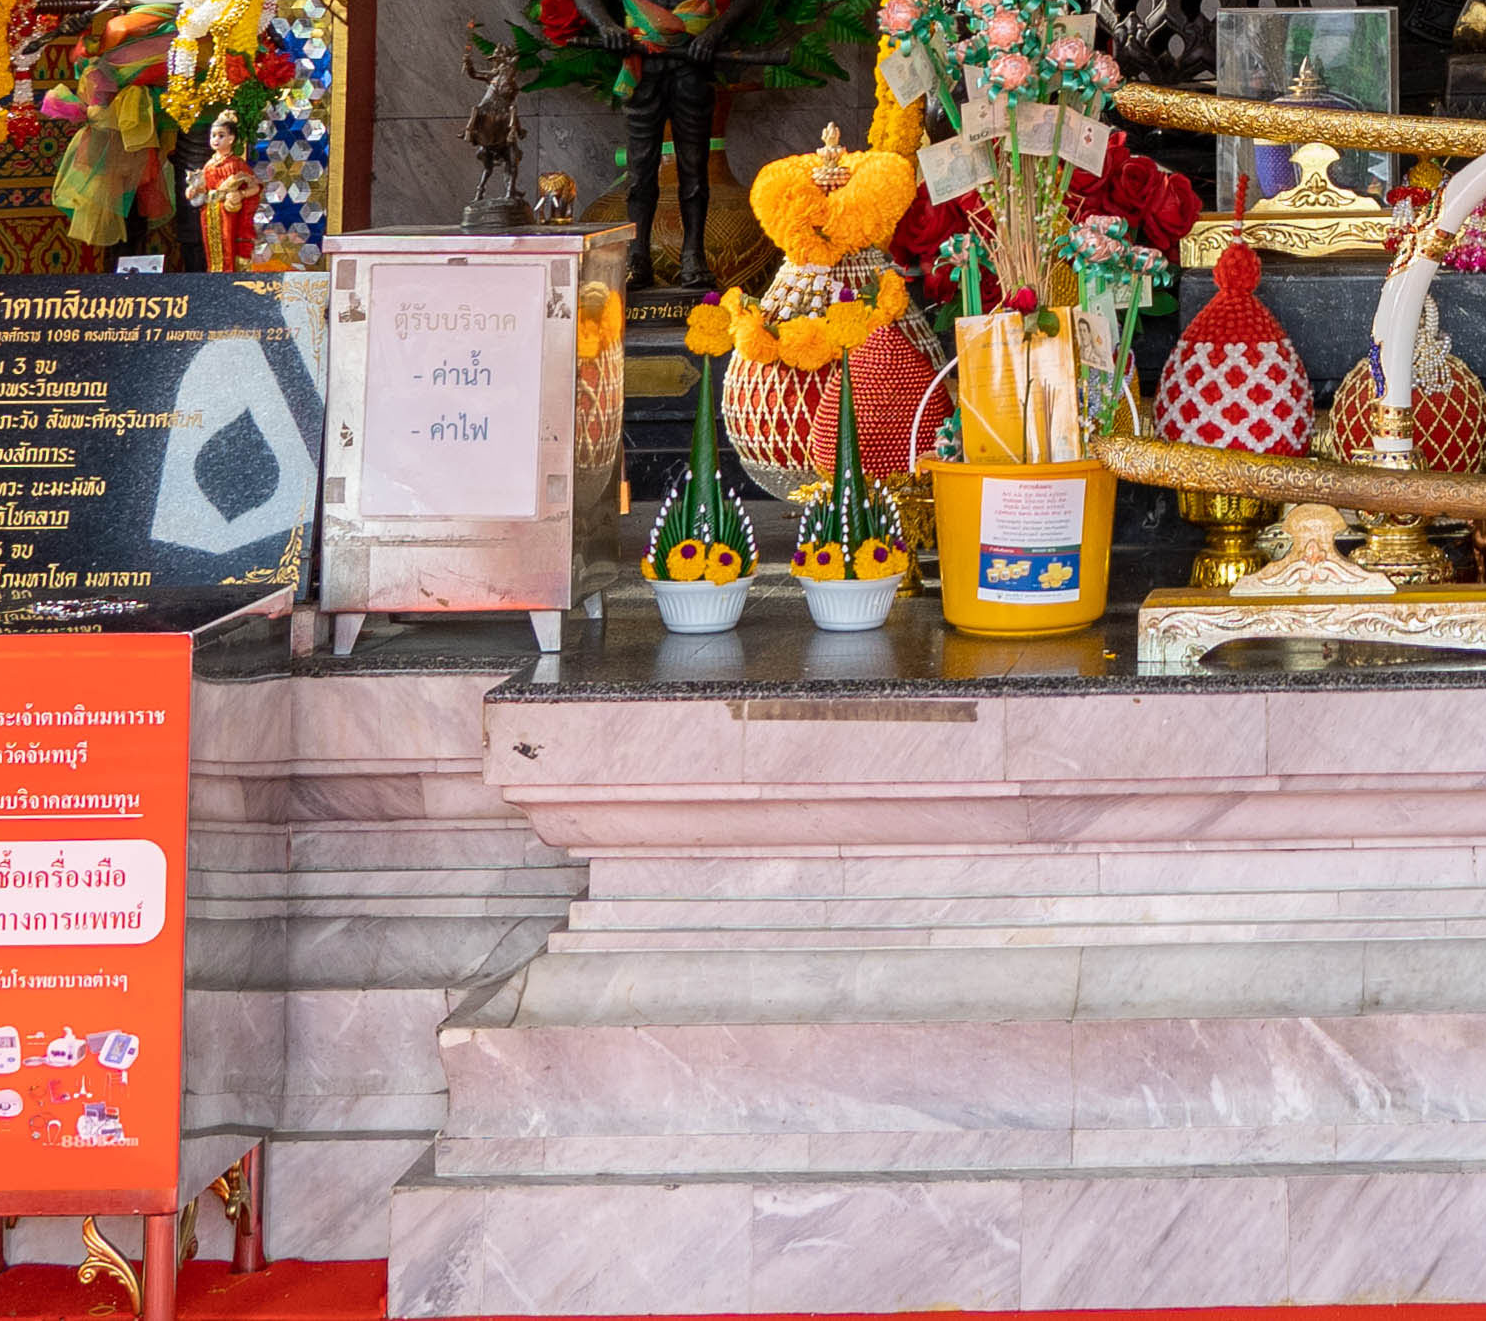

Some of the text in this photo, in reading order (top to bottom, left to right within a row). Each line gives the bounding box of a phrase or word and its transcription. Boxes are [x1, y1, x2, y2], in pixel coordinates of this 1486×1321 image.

[394, 302, 517, 341] ตู้รับบริจาค
[46, 328, 81, 343] 1096
[145, 327, 162, 341] 17
[13, 357, 27, 375] 3
[34, 357, 58, 375] จบ
[432, 349, 492, 387] ค่าน้ำ
[430, 412, 489, 442] ค่าไฟ
[10, 541, 34, 560] จบ
